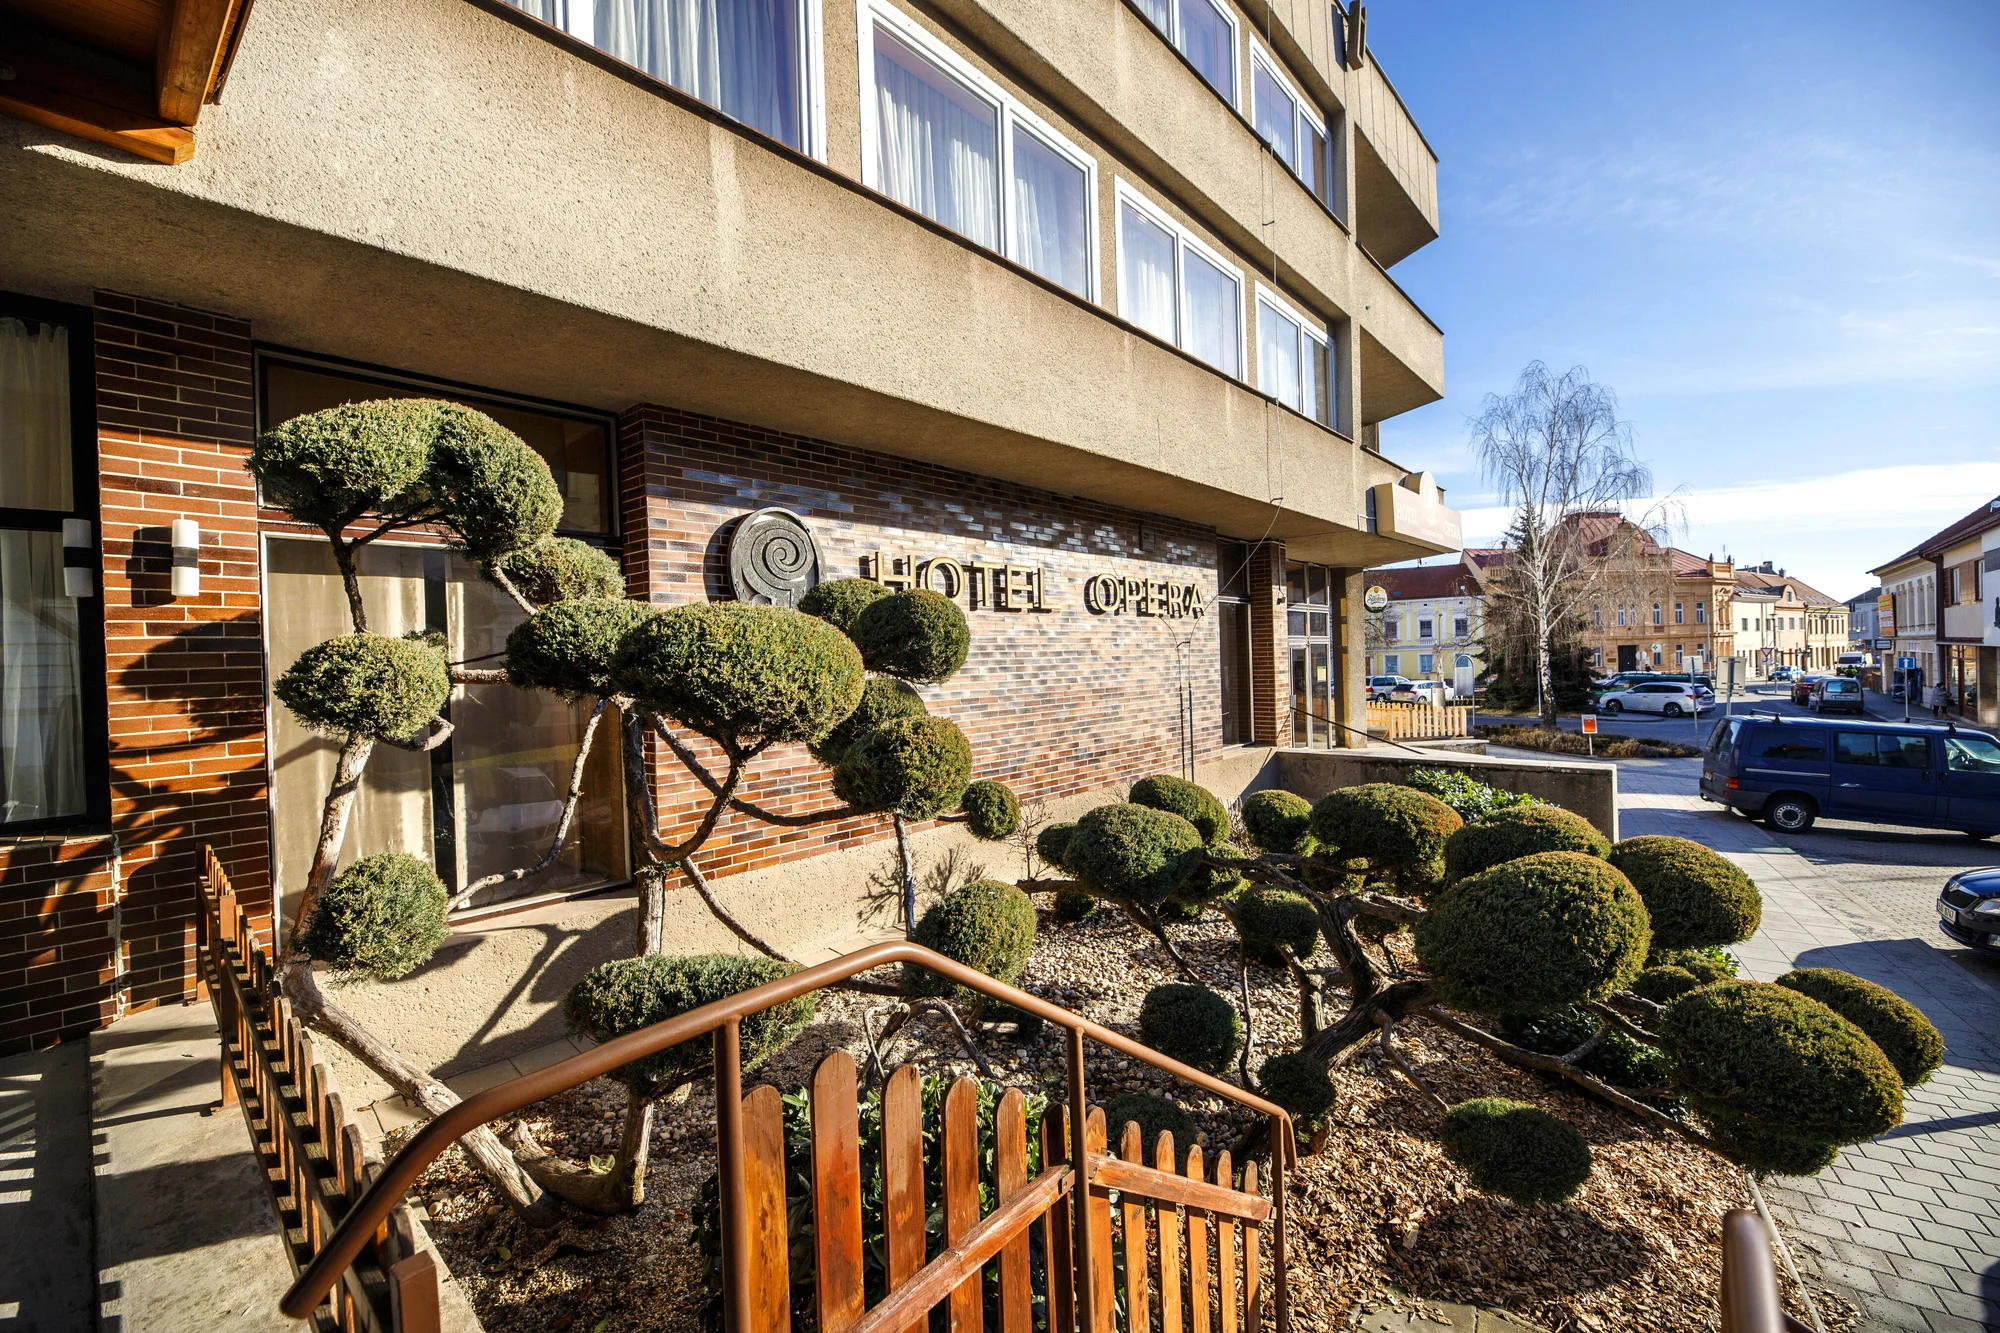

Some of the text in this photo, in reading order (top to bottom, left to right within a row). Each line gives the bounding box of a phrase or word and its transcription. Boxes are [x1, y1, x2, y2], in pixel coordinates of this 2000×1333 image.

[1396, 503, 1418, 526] HOTEL
[1445, 521, 1461, 541] OPERA
[875, 551, 1206, 617] HOTEL OPERA
